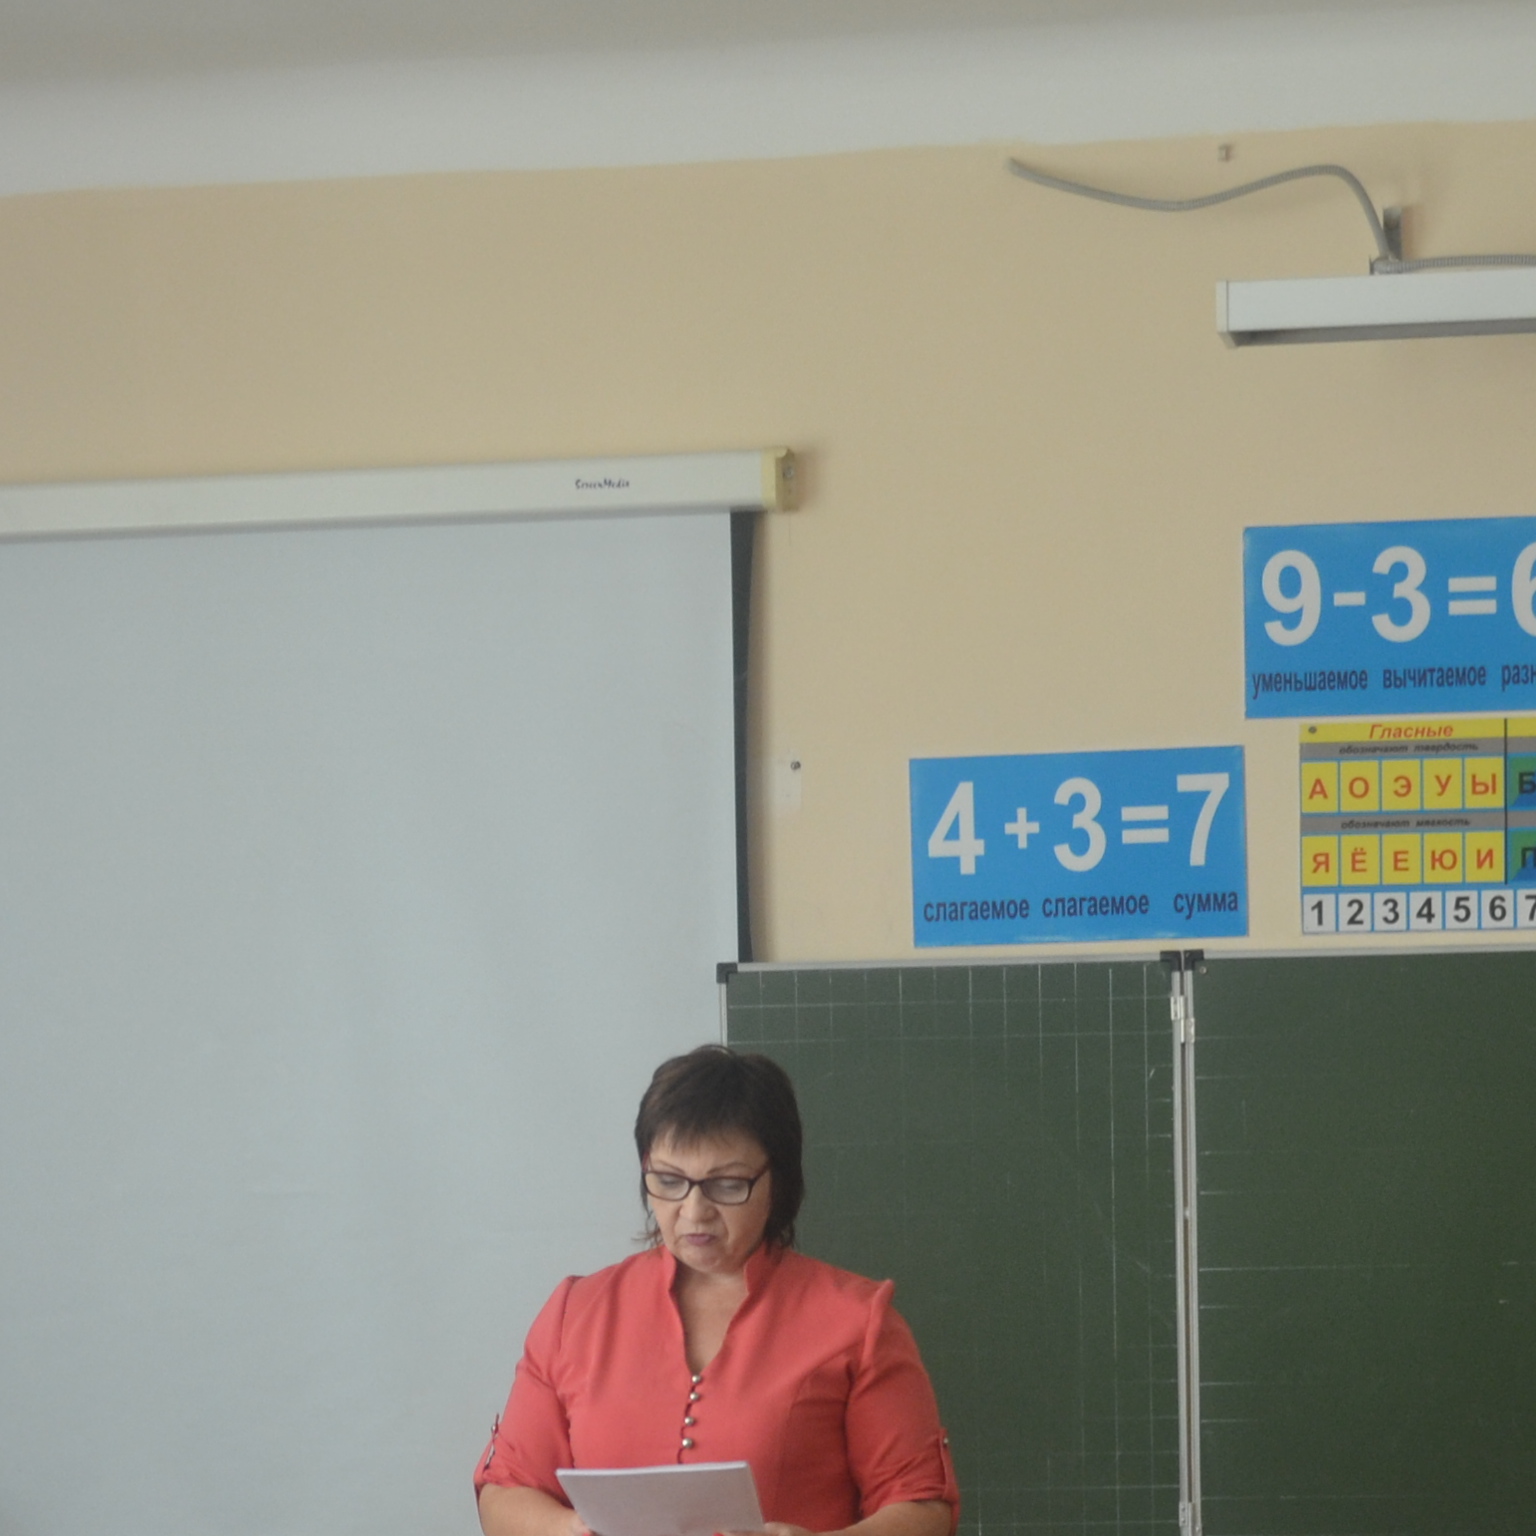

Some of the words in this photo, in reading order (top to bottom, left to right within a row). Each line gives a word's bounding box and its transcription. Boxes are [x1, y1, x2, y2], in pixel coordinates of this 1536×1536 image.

[1252, 669, 1368, 699] уменьшаемое
[1383, 665, 1486, 690] вычитаемое
[1369, 723, 1453, 739] Гласные
[1339, 744, 1408, 755] обозначают
[1309, 778, 1328, 799] А
[1348, 777, 1369, 799] О
[1393, 775, 1412, 797] Э
[1435, 774, 1452, 796] У
[1471, 773, 1497, 795] Ы
[1518, 772, 1536, 794] Б
[1340, 819, 1410, 830] обозначают
[1312, 852, 1330, 874] Я
[1351, 848, 1367, 873] Ё
[1393, 850, 1409, 872] Е
[1431, 849, 1457, 871] Ю
[1476, 848, 1493, 869] И
[924, 898, 1029, 922] слагаемое
[1042, 894, 1150, 918] слагаемое
[1174, 891, 1238, 920] сумма
[1310, 900, 1323, 926] 1
[1347, 899, 1364, 925] 2
[1382, 898, 1399, 925] 3
[1416, 898, 1435, 923] 4
[1453, 897, 1471, 923] 5
[1489, 896, 1507, 922] 6
